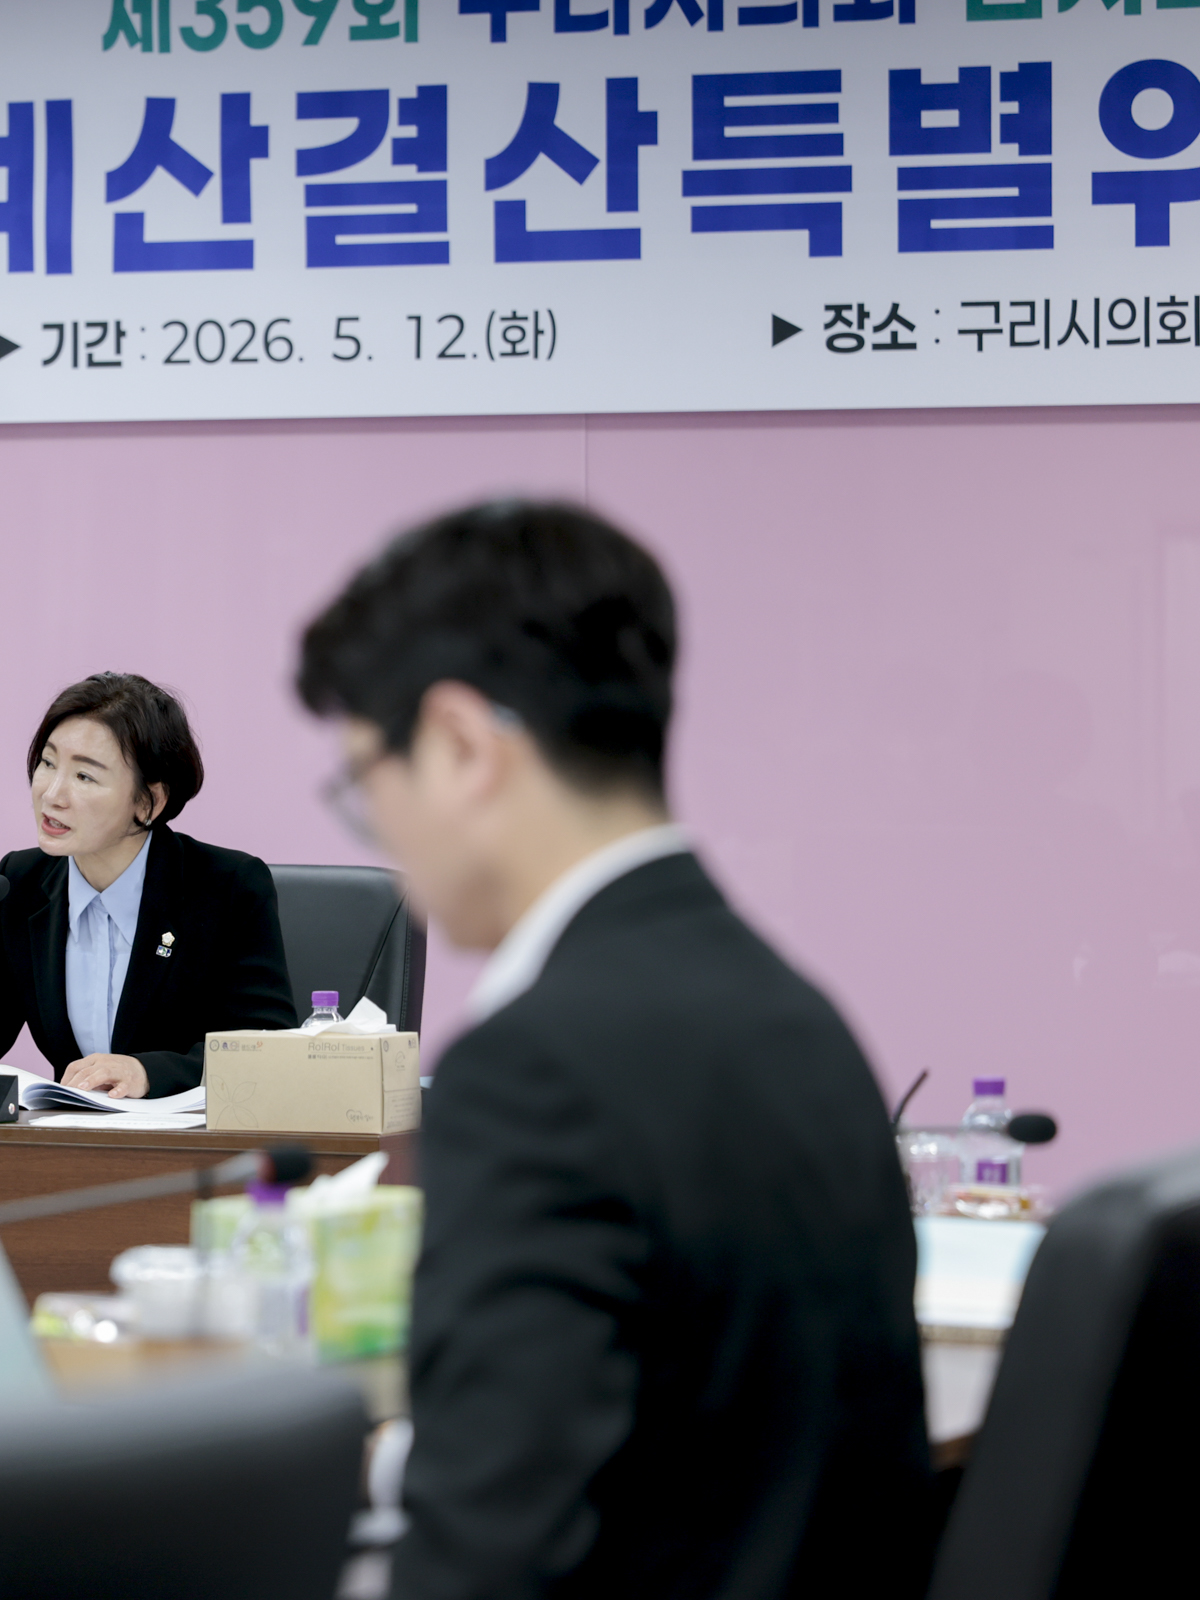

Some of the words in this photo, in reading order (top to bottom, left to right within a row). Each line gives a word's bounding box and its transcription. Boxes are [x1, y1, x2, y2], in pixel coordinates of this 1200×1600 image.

[41, 318, 126, 368] 기간
[161, 317, 304, 364] 2026.
[332, 316, 373, 361] 5.
[823, 302, 917, 354] 장소
